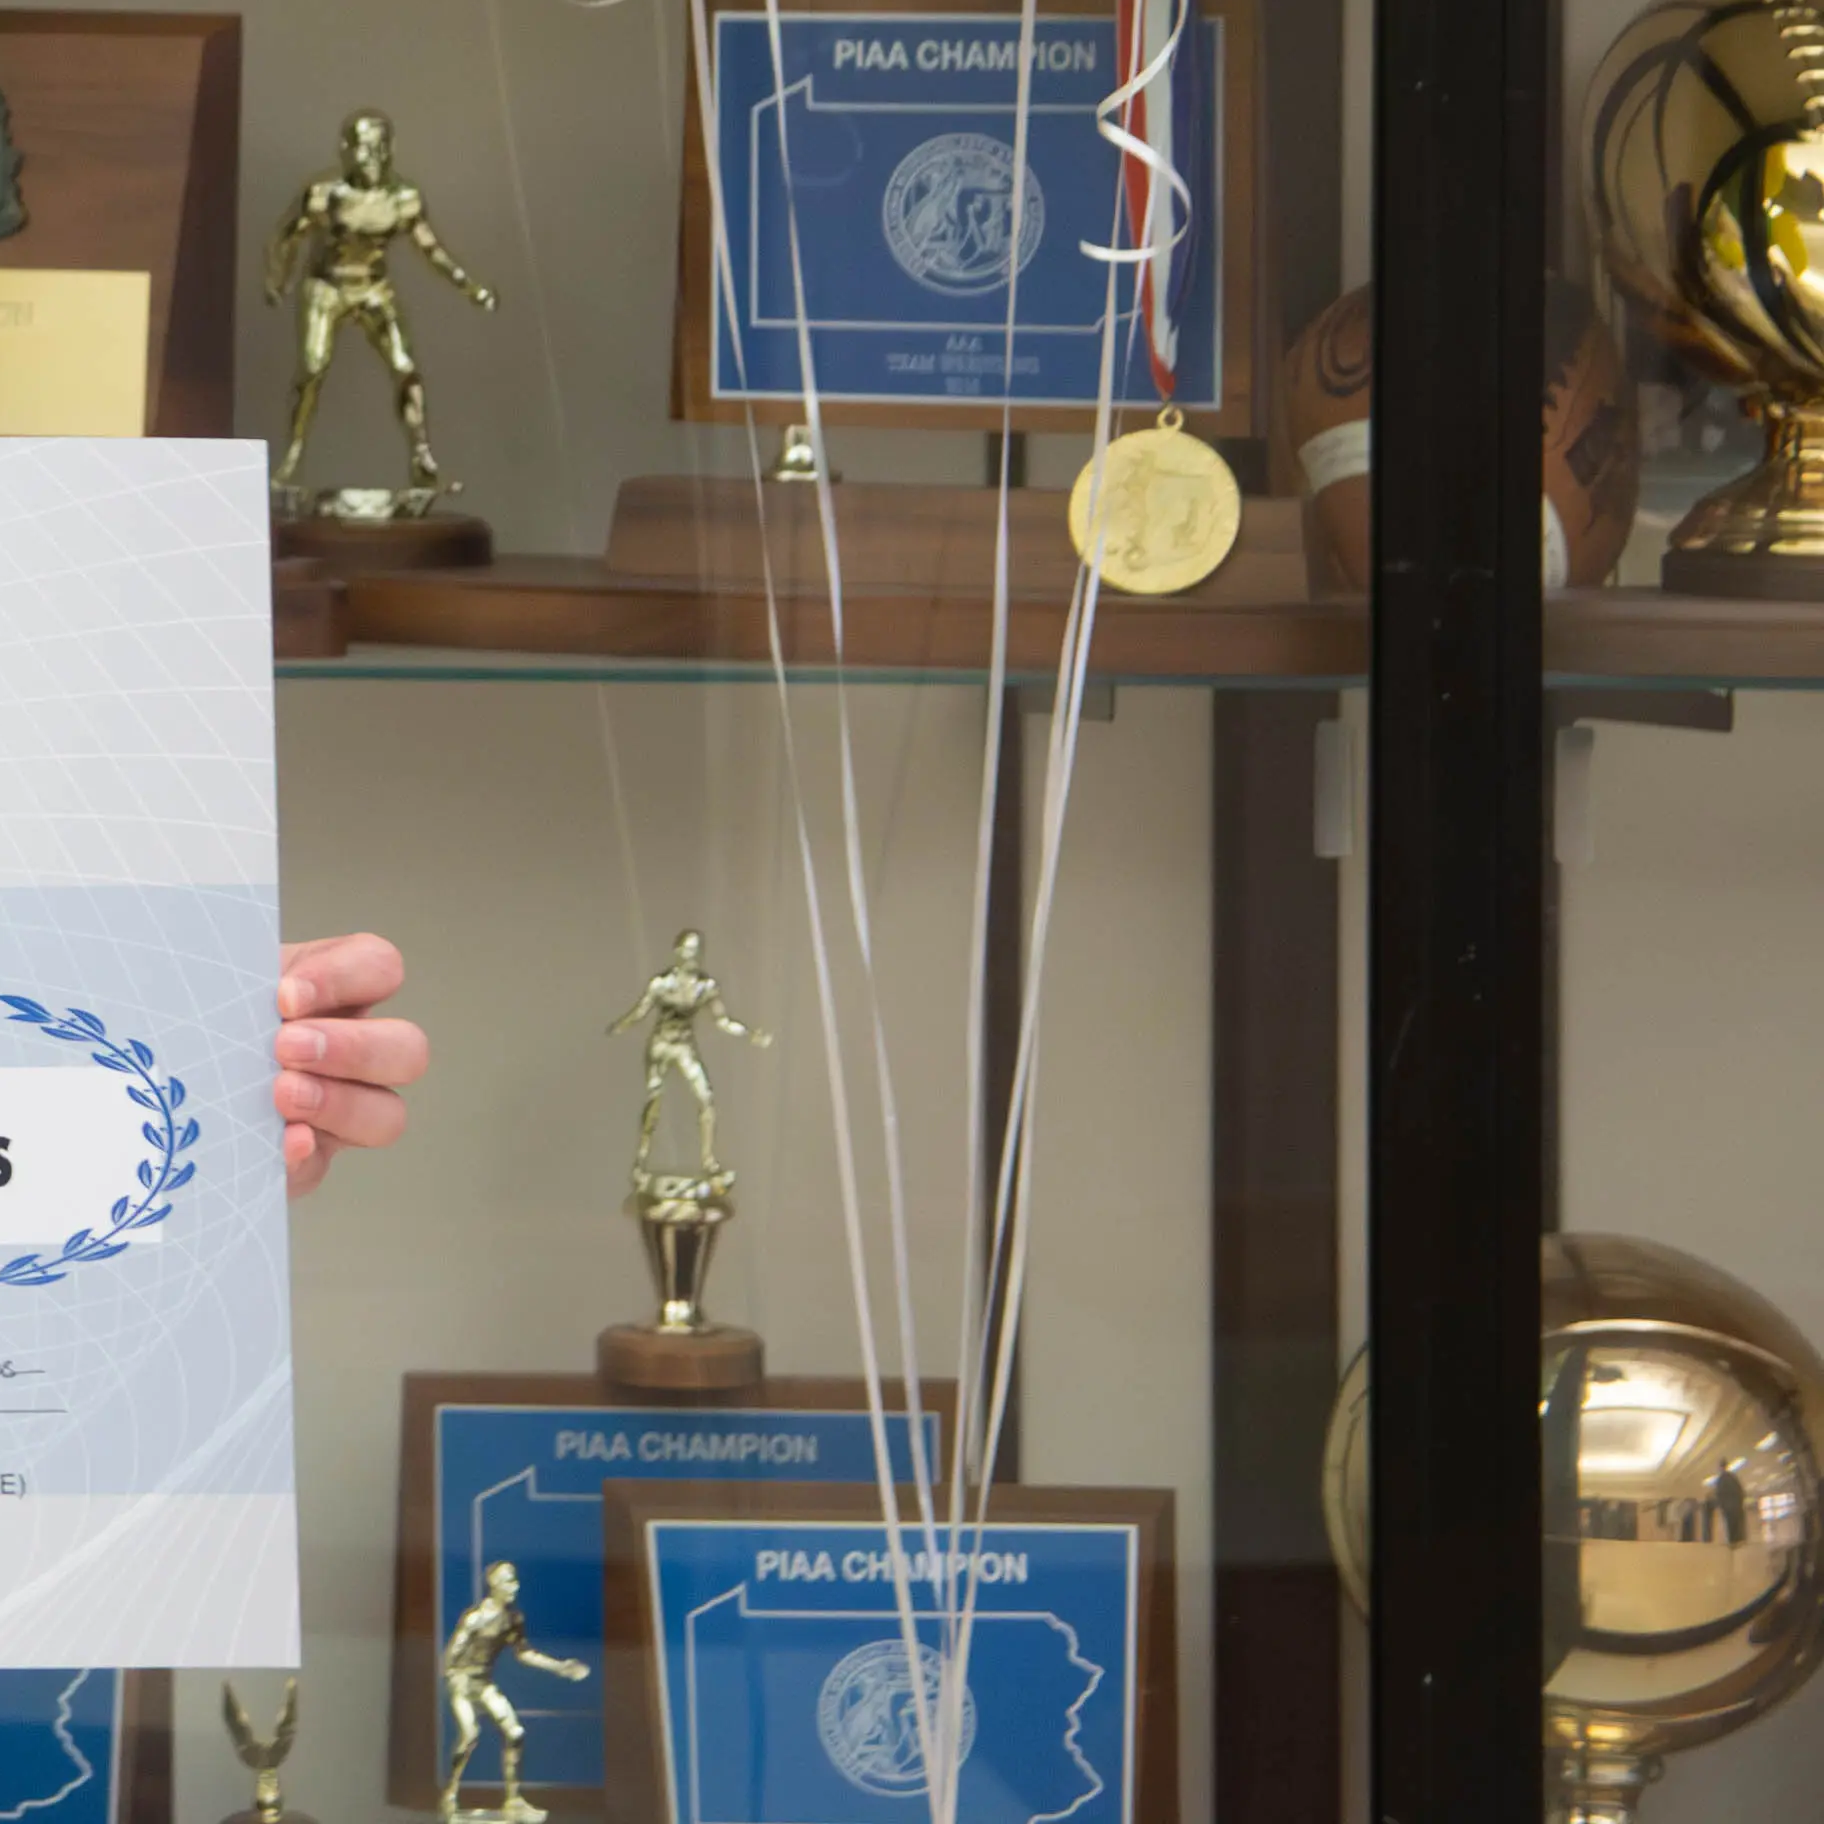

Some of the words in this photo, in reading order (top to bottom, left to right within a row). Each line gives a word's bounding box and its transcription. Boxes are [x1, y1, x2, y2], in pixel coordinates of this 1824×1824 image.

[833, 39, 909, 71] PIAA
[555, 1428, 633, 1462] PIAA
[638, 1429, 818, 1464] CHAMPION
[755, 1550, 836, 1584] PIAA
